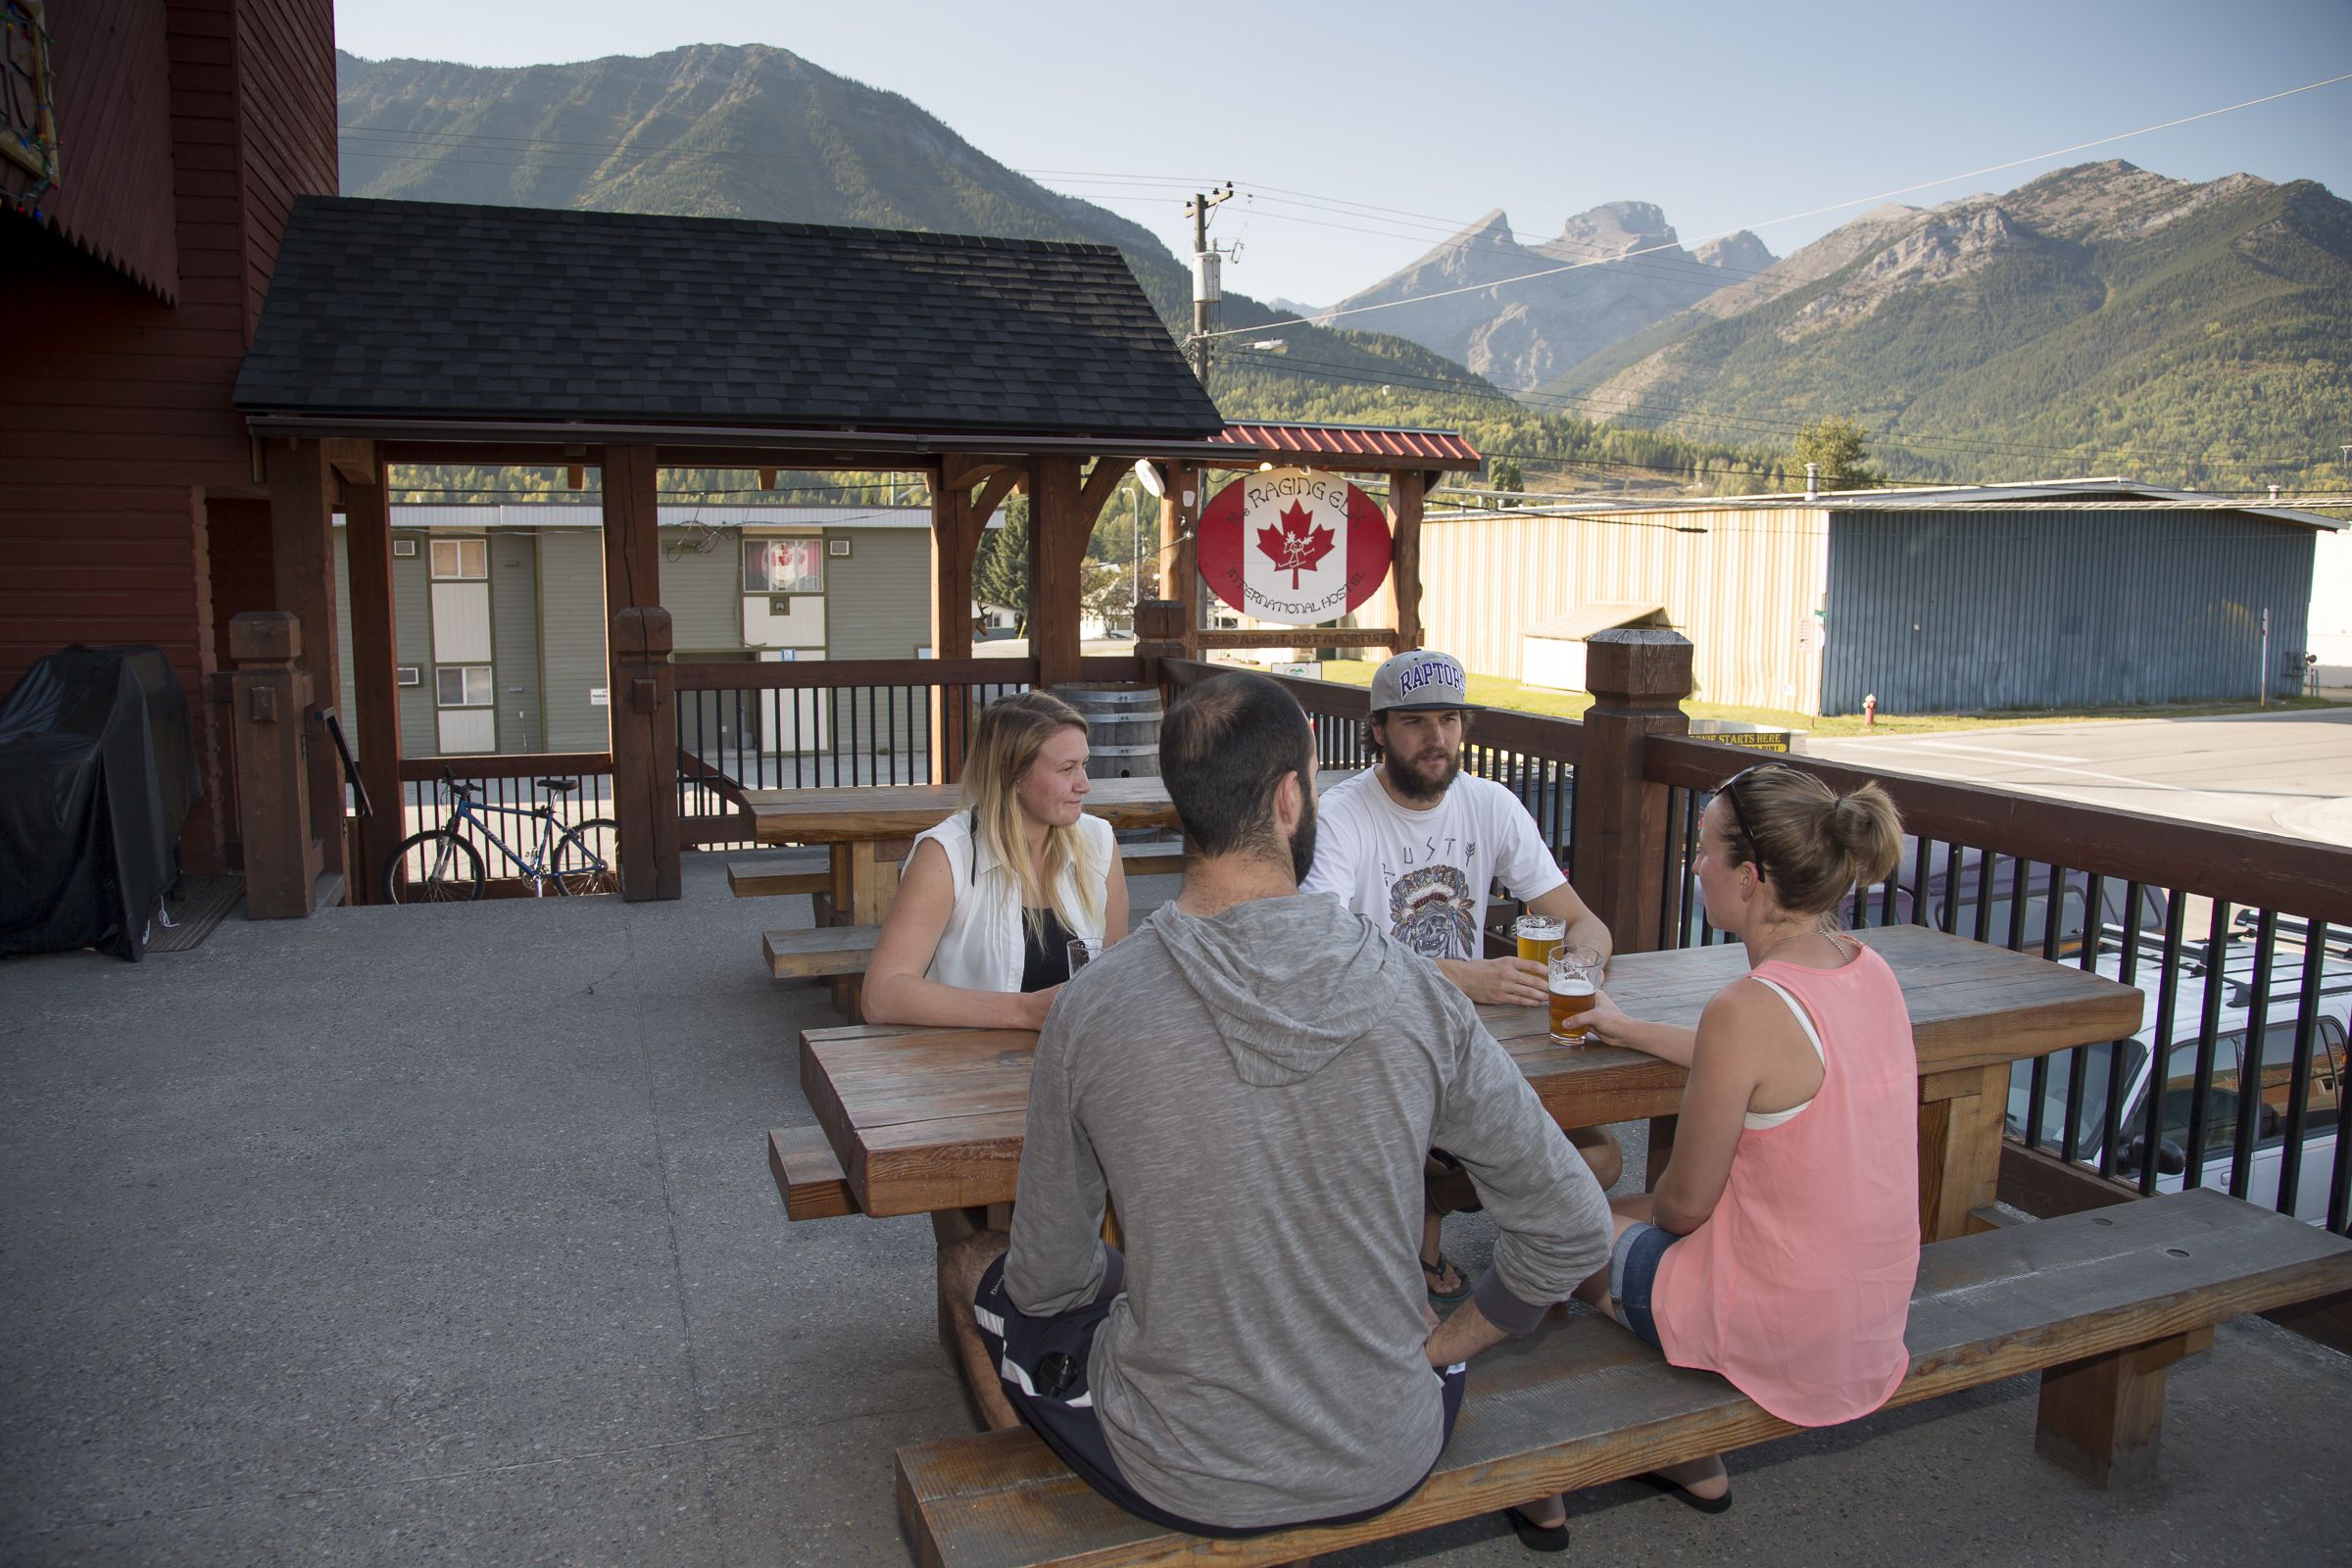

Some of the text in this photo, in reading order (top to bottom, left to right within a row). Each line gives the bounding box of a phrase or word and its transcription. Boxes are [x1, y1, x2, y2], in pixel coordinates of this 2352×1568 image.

[1248, 477, 1326, 508] RAGING
[1329, 491, 1365, 529] ELK
[1227, 567, 1366, 614] INTERNATIONAL HOSTEL
[1718, 734, 1754, 744] STARTS
[1756, 734, 1781, 743] HERE
